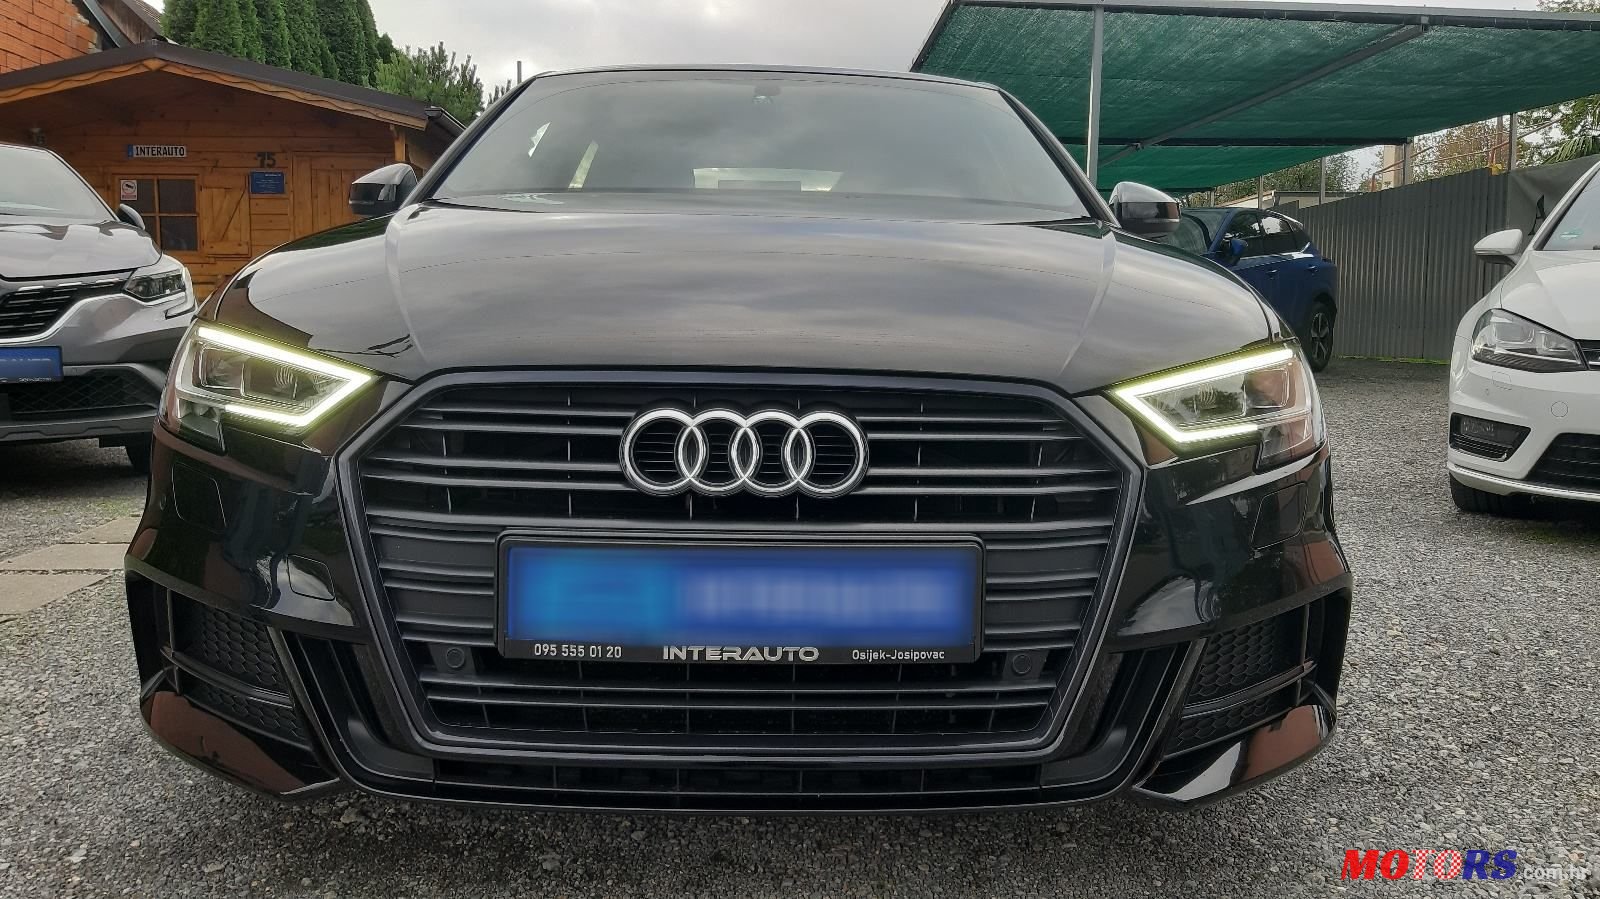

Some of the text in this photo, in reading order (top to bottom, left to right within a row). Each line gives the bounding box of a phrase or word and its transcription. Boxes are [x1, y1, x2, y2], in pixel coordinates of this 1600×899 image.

[135, 146, 185, 157] INTERAUTO
[256, 152, 276, 168] 75
[534, 643, 622, 659] 095 555 01 20
[662, 645, 820, 662] INTERAUTO
[852, 649, 945, 662] Osijek-Josipovac
